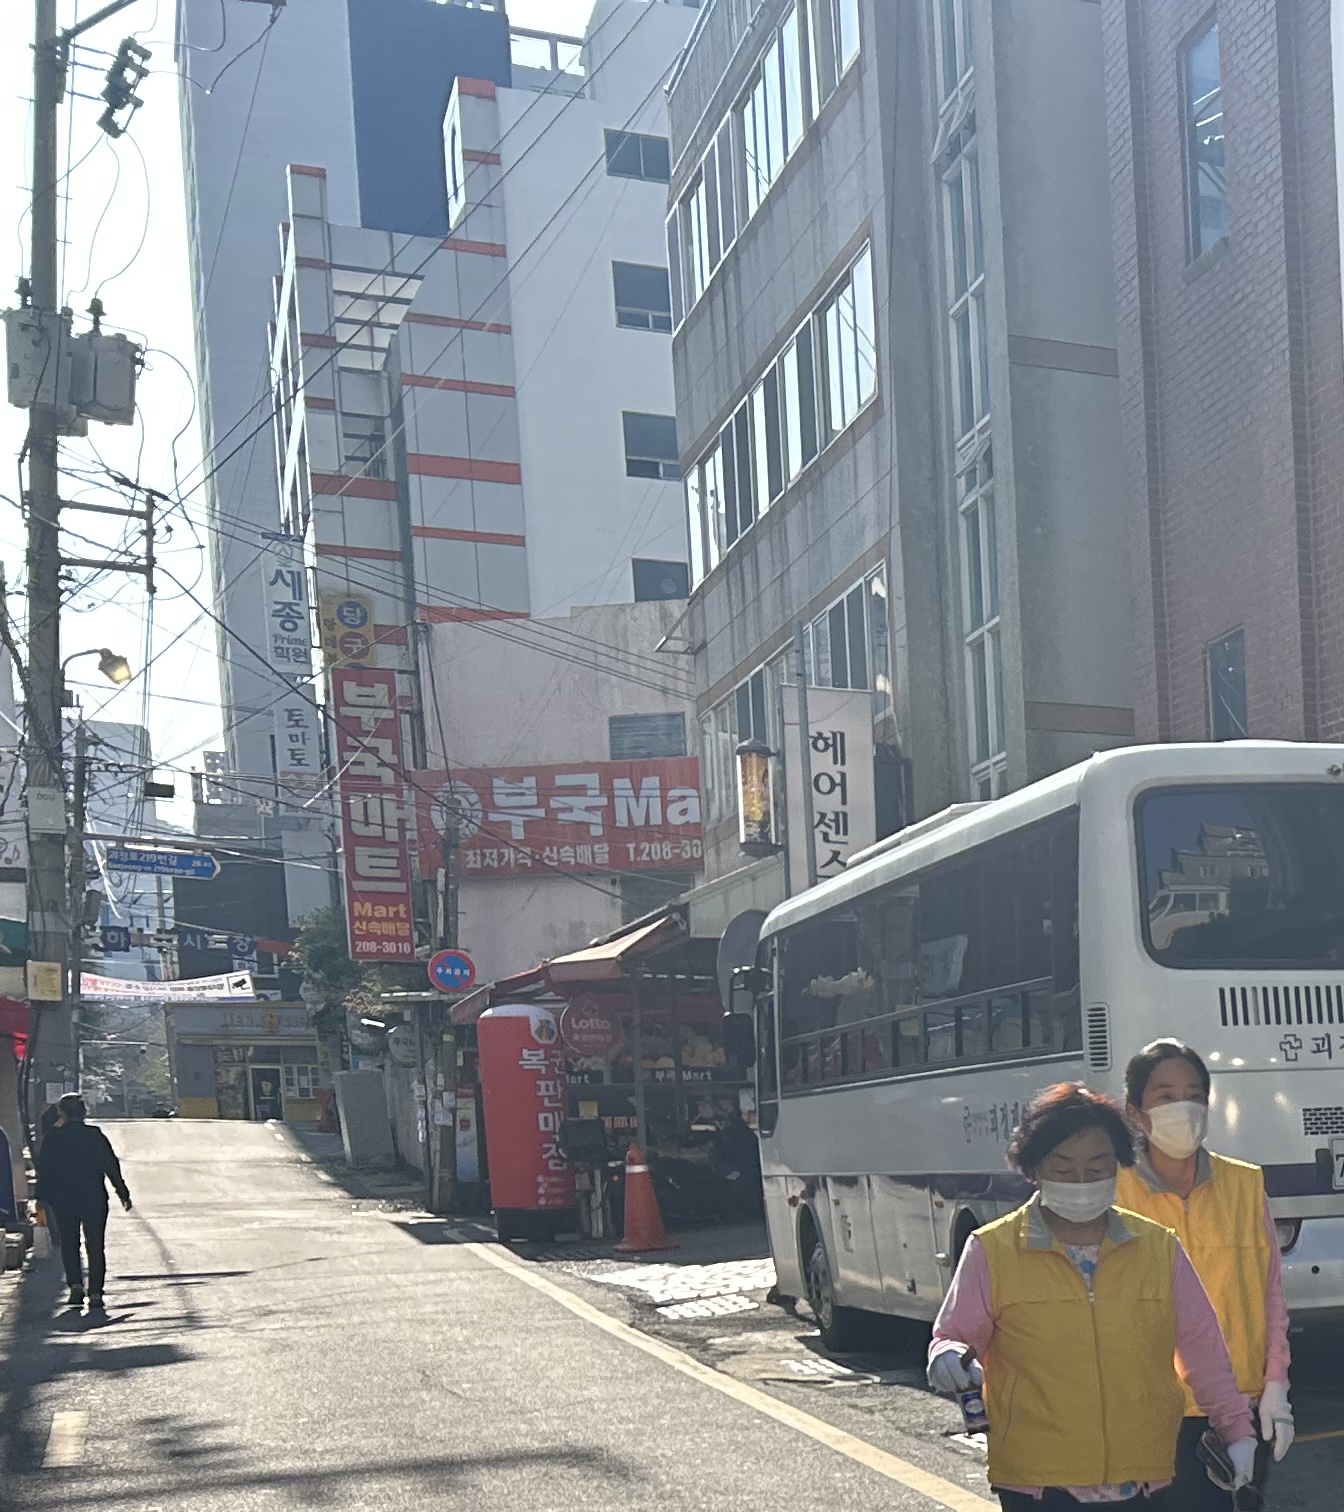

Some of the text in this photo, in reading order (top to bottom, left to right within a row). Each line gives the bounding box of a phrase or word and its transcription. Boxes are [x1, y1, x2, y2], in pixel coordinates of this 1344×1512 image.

[268, 568, 305, 633] 세종
[271, 633, 309, 646] Prime
[272, 645, 310, 664] 학원
[283, 708, 311, 767] 토마토
[339, 680, 407, 893] 부국마트
[352, 900, 408, 919] Mart
[352, 919, 411, 937] 신속배달
[354, 939, 411, 954] 208-3010
[570, 1017, 611, 1030] Lotto
